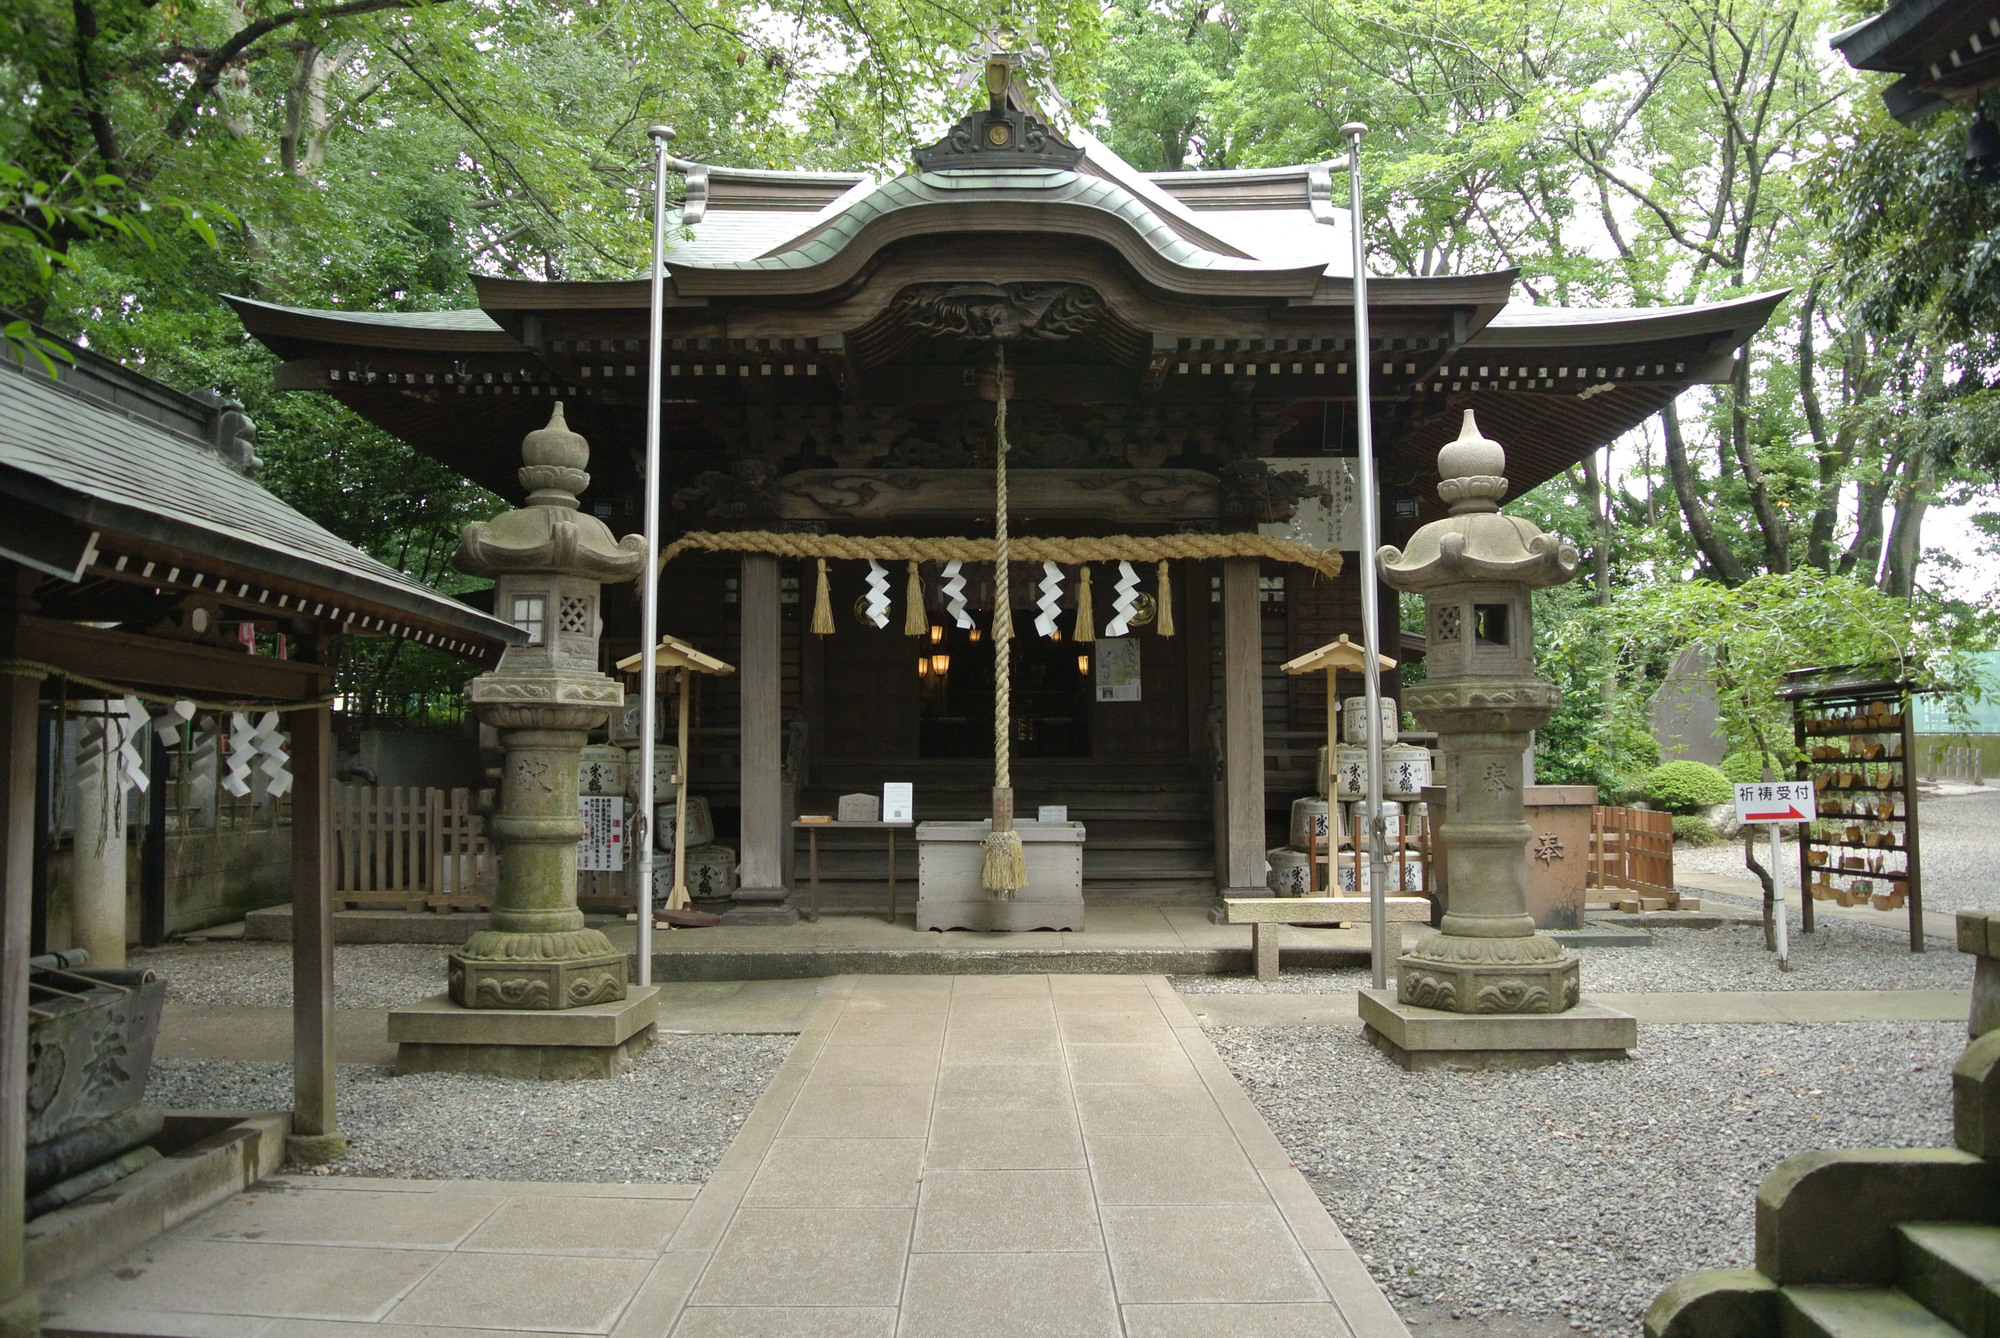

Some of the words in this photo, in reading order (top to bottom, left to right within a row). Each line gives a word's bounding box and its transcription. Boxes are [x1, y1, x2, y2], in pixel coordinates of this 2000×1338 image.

[588, 762, 602, 793] 米鶴
[1348, 762, 1361, 793] 米鶴
[1399, 762, 1413, 793] 米鶴
[1482, 762, 1514, 800] 奉
[1739, 785, 1809, 802] 祈祷受付
[612, 819, 621, 843] 注意
[1534, 832, 1564, 867] 奉
[698, 864, 713, 895] 米鶴
[1290, 866, 1305, 897] 米鶴
